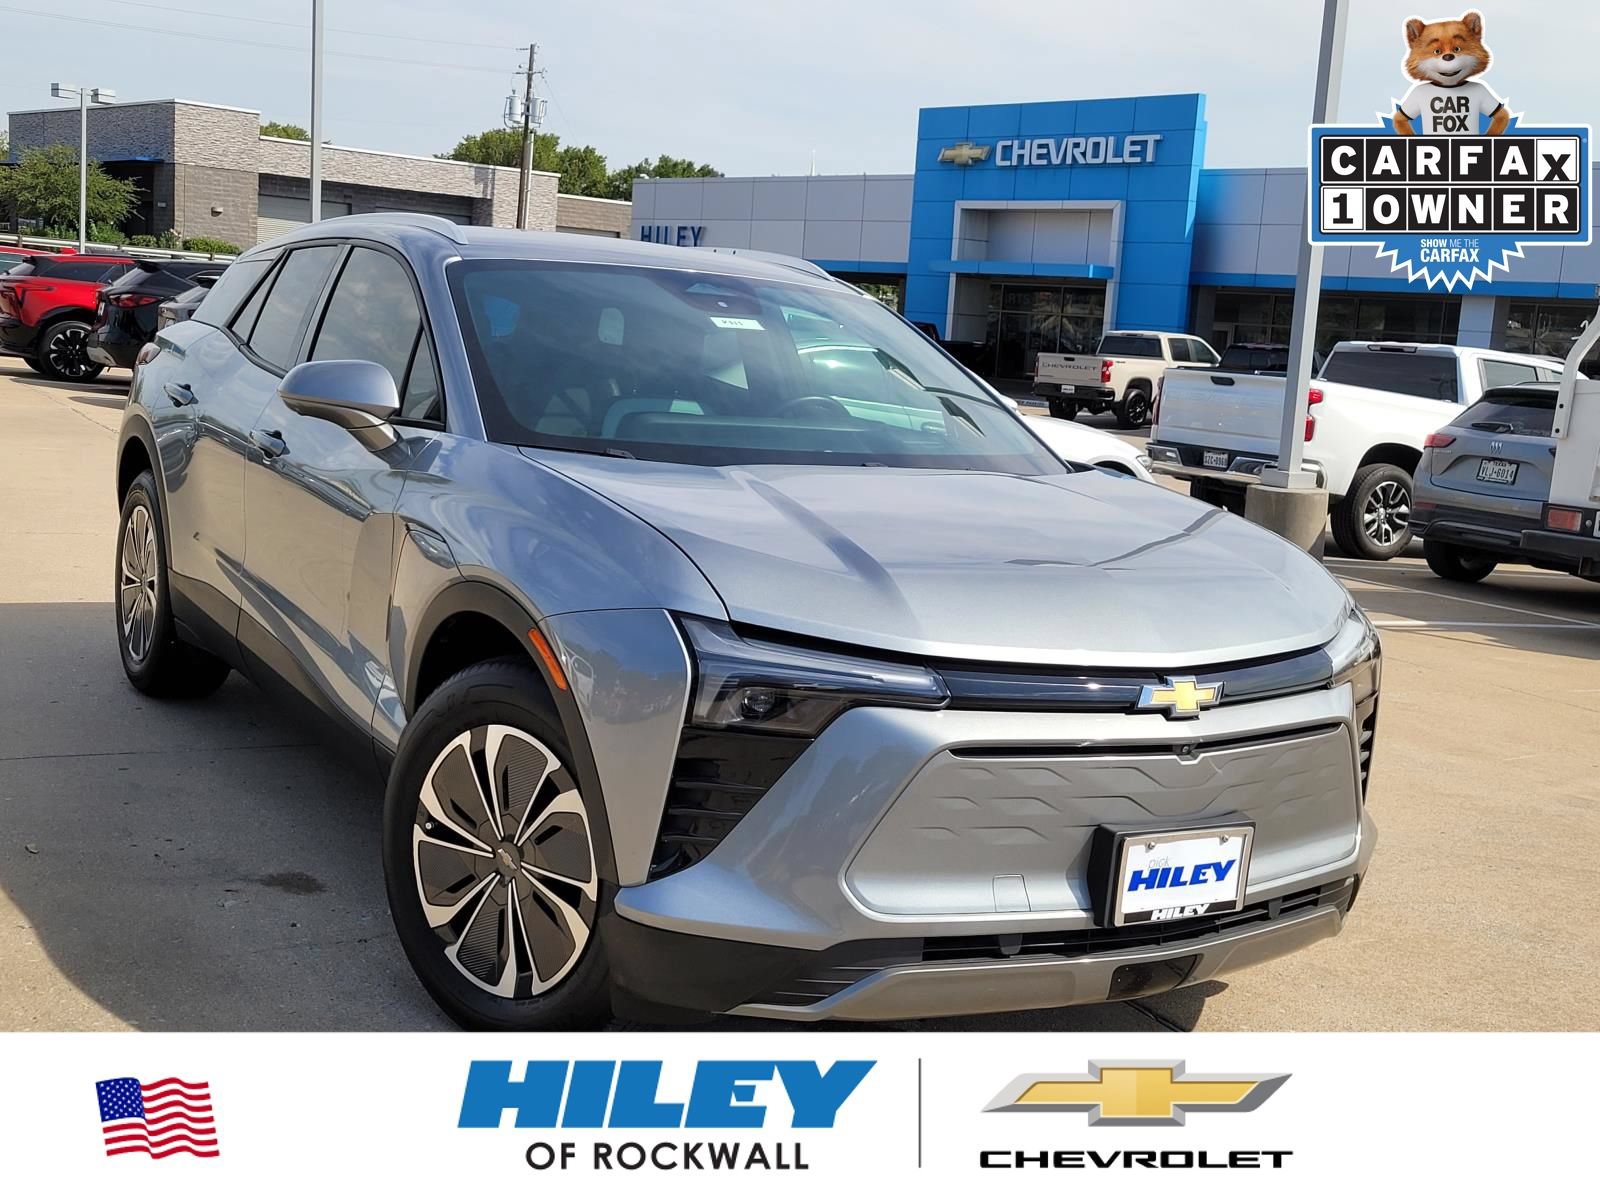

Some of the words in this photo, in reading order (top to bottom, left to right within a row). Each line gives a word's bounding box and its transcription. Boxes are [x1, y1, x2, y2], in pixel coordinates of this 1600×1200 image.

[995, 134, 1163, 166] CHEVROLET
[1042, 361, 1097, 371] CHEVROLET
[1127, 859, 1236, 892] HILEY
[1151, 903, 1210, 921] HILEY
